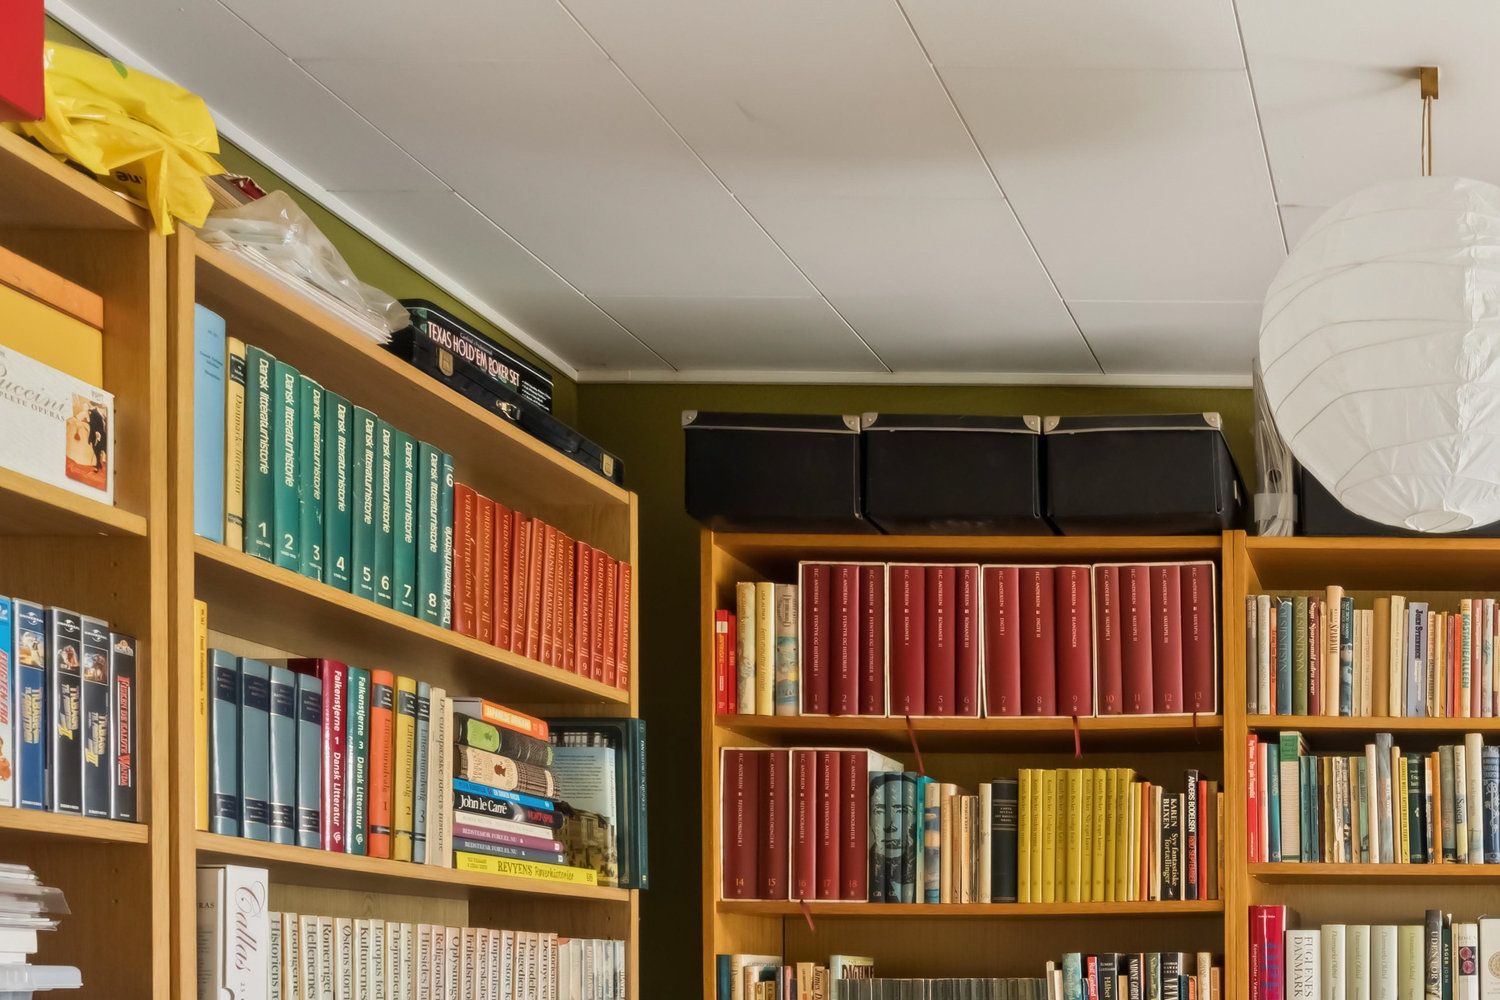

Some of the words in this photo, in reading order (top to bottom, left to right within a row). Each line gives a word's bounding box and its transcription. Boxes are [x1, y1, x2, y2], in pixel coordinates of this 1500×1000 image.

[427, 321, 452, 349] TEXAS
[452, 339, 487, 367] HOLD'EM
[488, 357, 509, 383] POKER
[509, 368, 520, 387] SET
[258, 357, 269, 391] Dansk
[284, 373, 295, 405] Dansk
[312, 389, 322, 419] Dansk
[337, 403, 346, 434] Dansk
[259, 393, 272, 474] litteraturhistorie
[284, 406, 295, 487] litteraturhistorie
[364, 418, 374, 448] Dansk
[382, 429, 392, 458] Dansk
[312, 420, 322, 500] litteraturhistorie
[404, 441, 414, 471] Dansk
[429, 452, 439, 480] Dansk
[337, 435, 347, 512] litteraturhistorie
[364, 449, 373, 525] litteraturhistorie
[382, 459, 392, 533] litteraturhistorie
[404, 472, 414, 543] litteraturhistorie
[258, 522, 267, 537] 1
[429, 481, 439, 553] litteraturhistorie
[284, 533, 294, 550] 2
[312, 544, 320, 561] 3
[335, 556, 345, 572] 4
[361, 566, 372, 582] 5
[381, 575, 389, 591] 6
[403, 583, 412, 599] 7
[428, 593, 437, 608] 8
[332, 670, 342, 732] Falkenstjerne
[357, 676, 366, 736] Falkenstjerne
[333, 752, 341, 780] Dansk
[356, 756, 365, 782] Dansk
[333, 782, 341, 827] Litteratur
[356, 782, 364, 829] Litteratur
[458, 794, 479, 810] John
[479, 797, 487, 805] le
[487, 799, 508, 814] Carré
[1162, 798, 1170, 829] BLIXEN
[1170, 798, 1178, 828] KAREN
[234, 880, 266, 972] Callas
[321, 923, 333, 993] Romerriget
